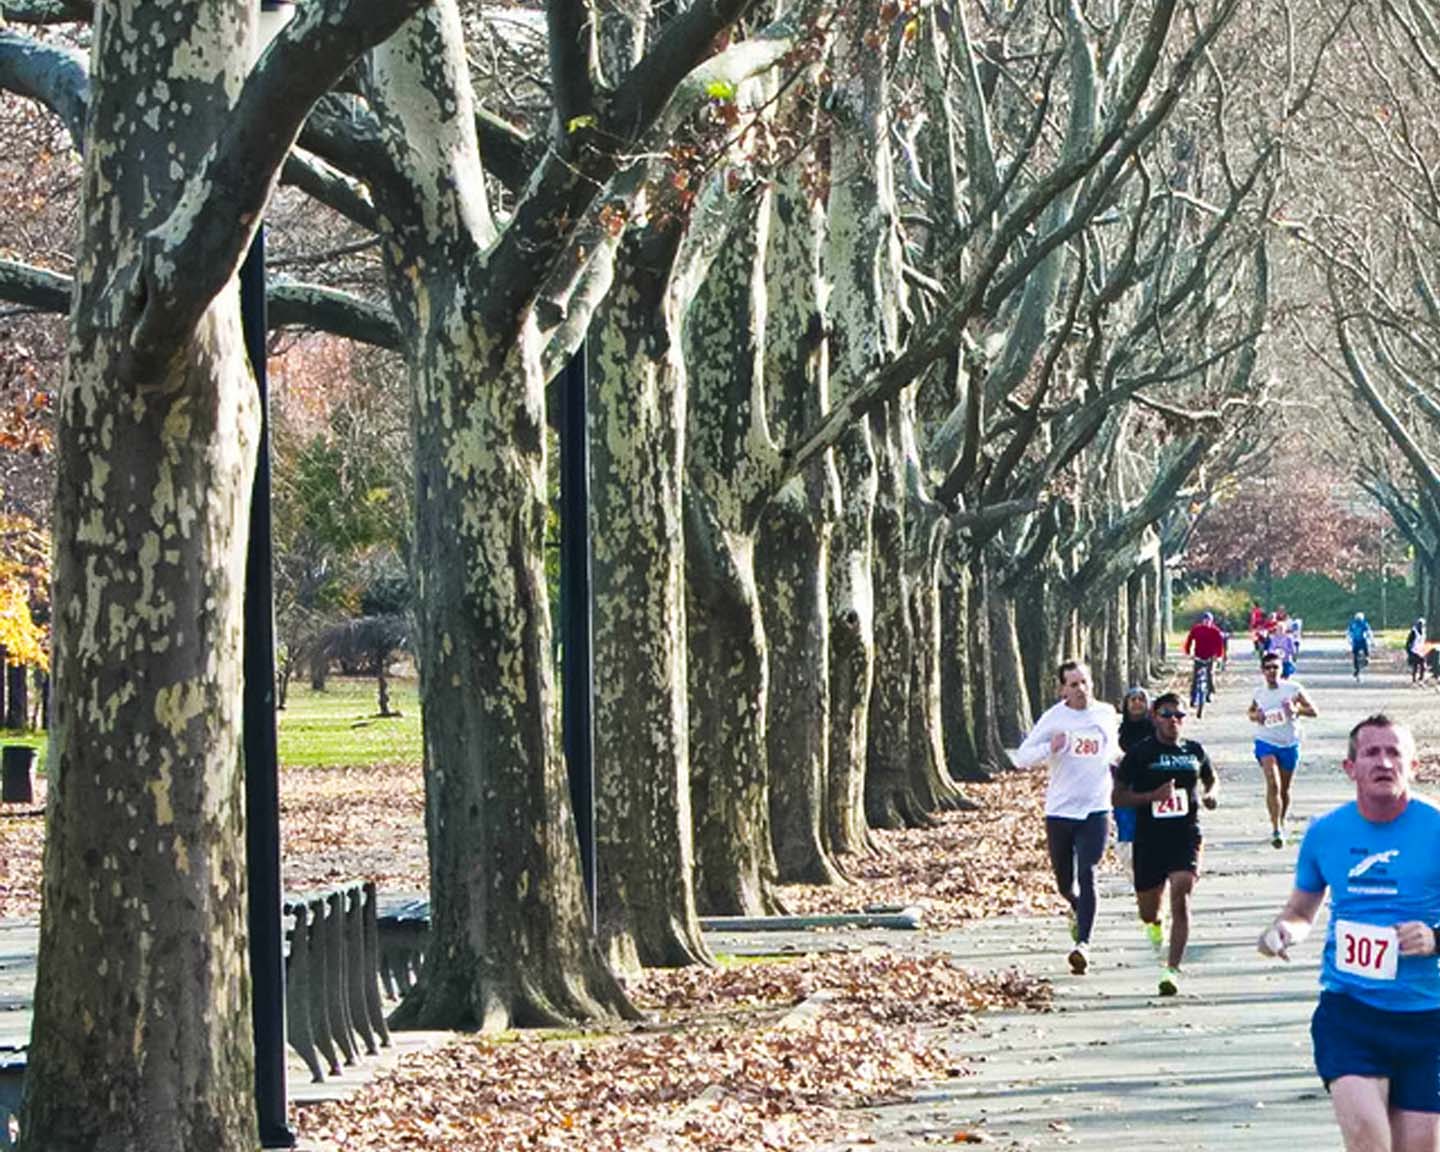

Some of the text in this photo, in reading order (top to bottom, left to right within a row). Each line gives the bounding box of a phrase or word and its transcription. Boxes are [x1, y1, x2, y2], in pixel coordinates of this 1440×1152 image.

[1075, 738, 1099, 755] 280
[1157, 796, 1184, 813] 241
[1345, 934, 1388, 969] 307
